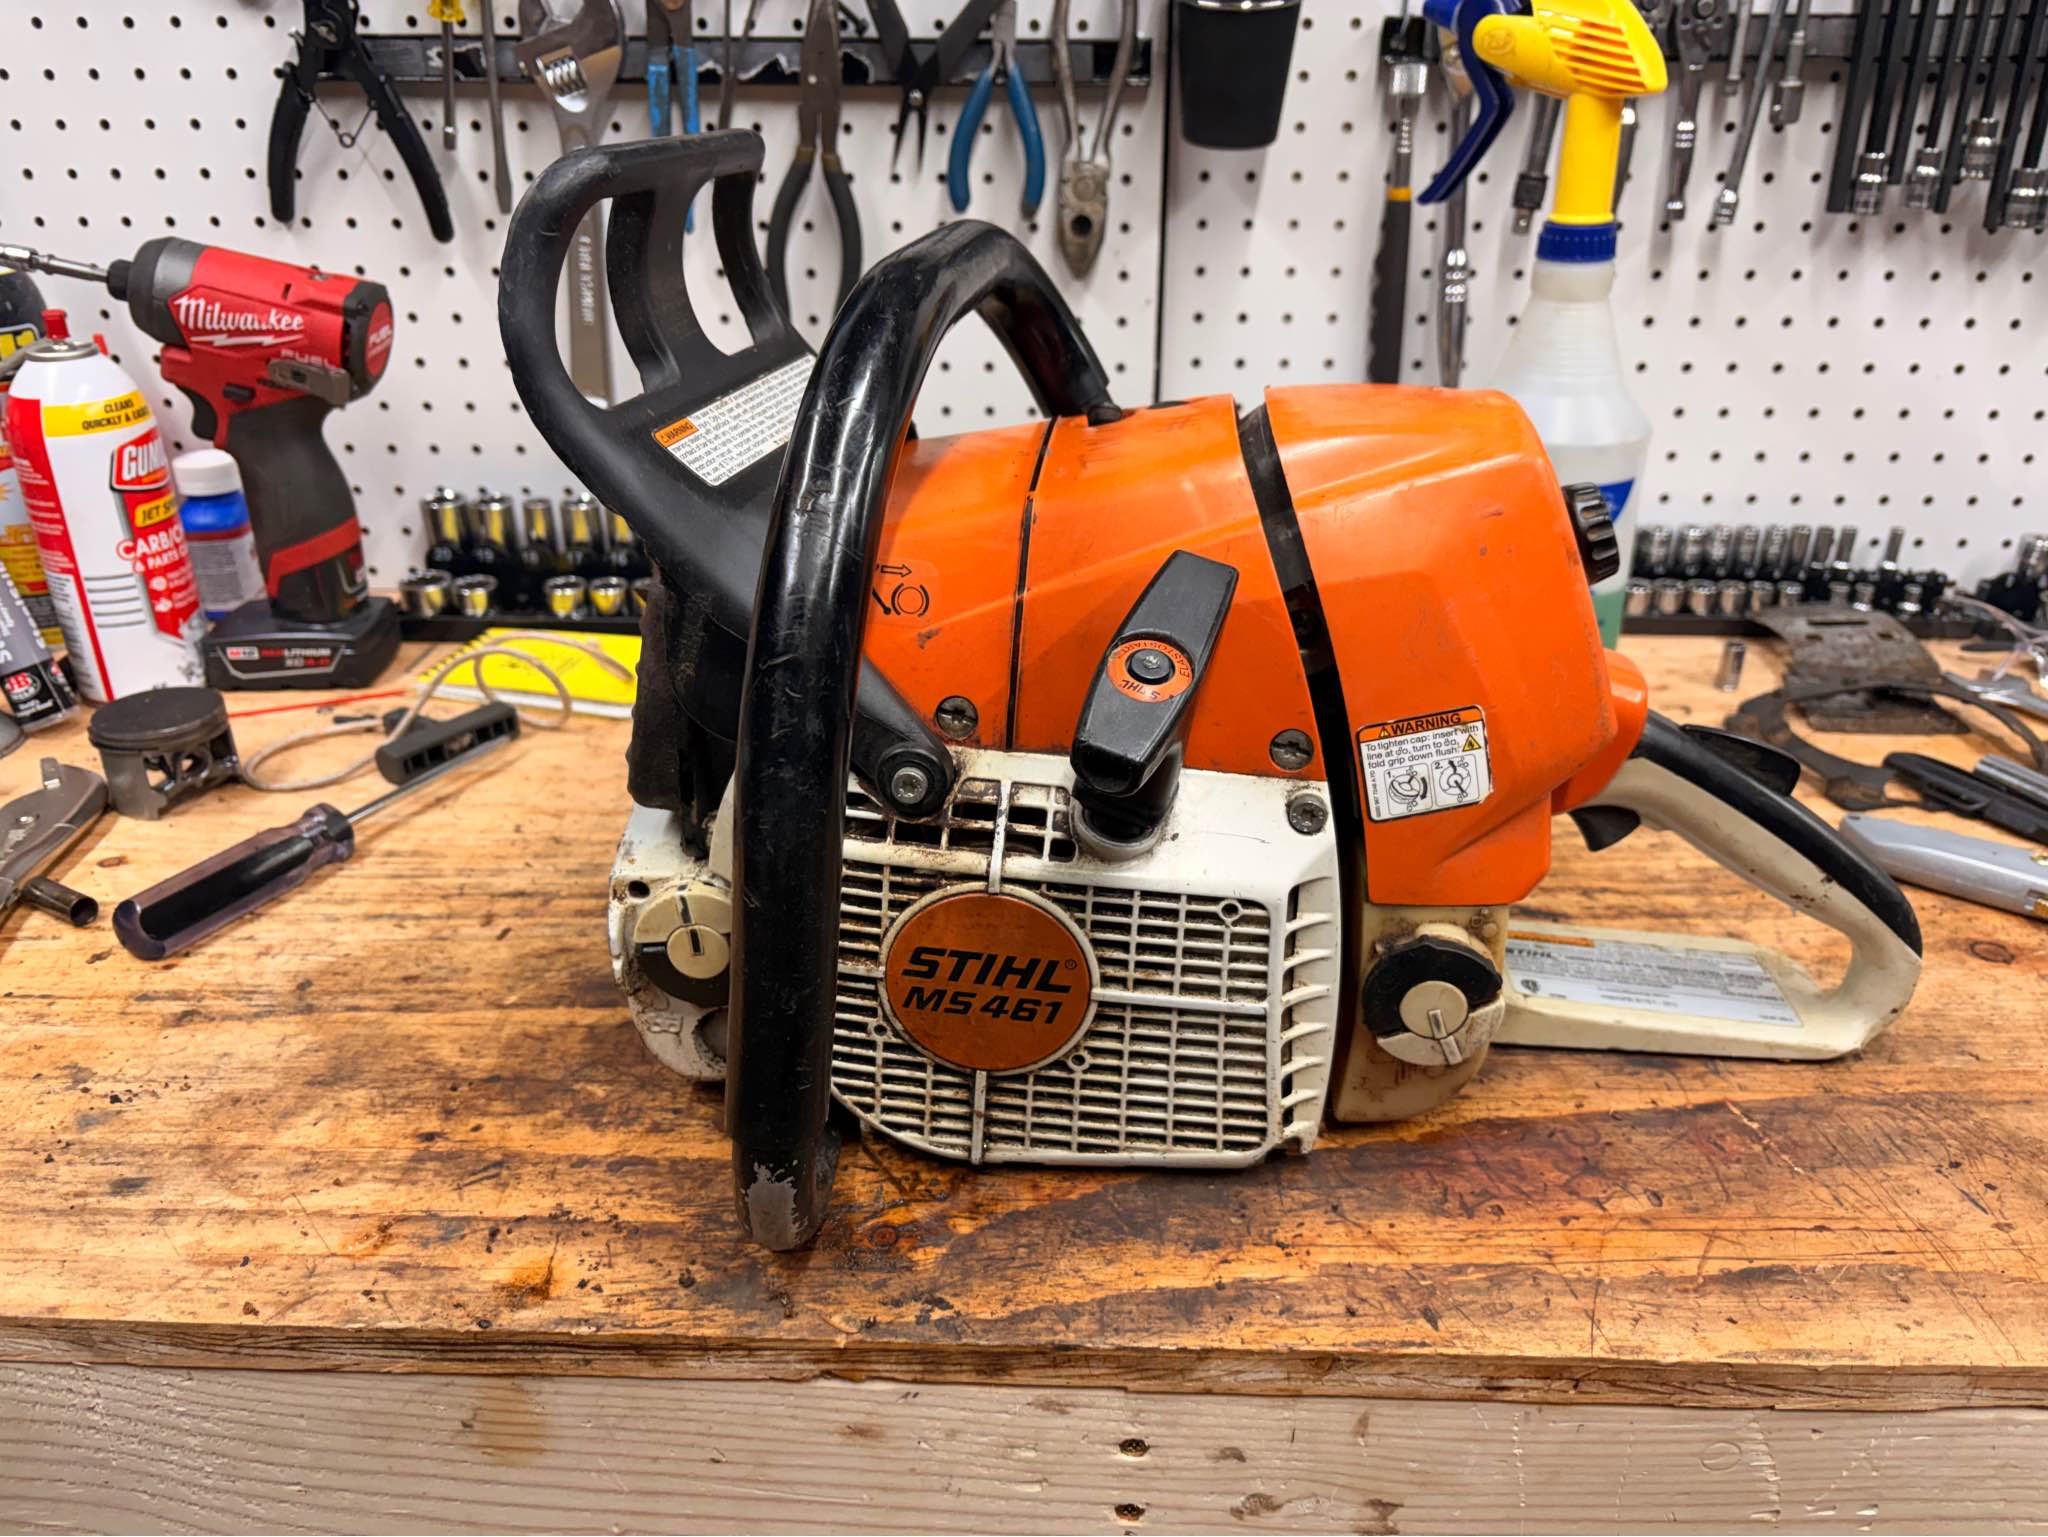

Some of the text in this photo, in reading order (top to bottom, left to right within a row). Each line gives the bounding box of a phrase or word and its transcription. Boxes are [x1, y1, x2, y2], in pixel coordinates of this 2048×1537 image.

[281, 349, 337, 370] FUEL
[104, 398, 134, 413] CLEANS
[82, 415, 122, 431] QUICKLY
[143, 505, 160, 524] JET
[1121, 679, 1161, 699] SIHL
[1391, 713, 1461, 736] WARNING
[1366, 725, 1478, 752] To tighten cap: insert with
[1367, 740, 1442, 761] line at turn to
[1368, 746, 1459, 770] fold grip down flush.
[1434, 761, 1443, 770] 2.
[901, 946, 1073, 994] STIHL
[902, 986, 1063, 1024] MS 461
